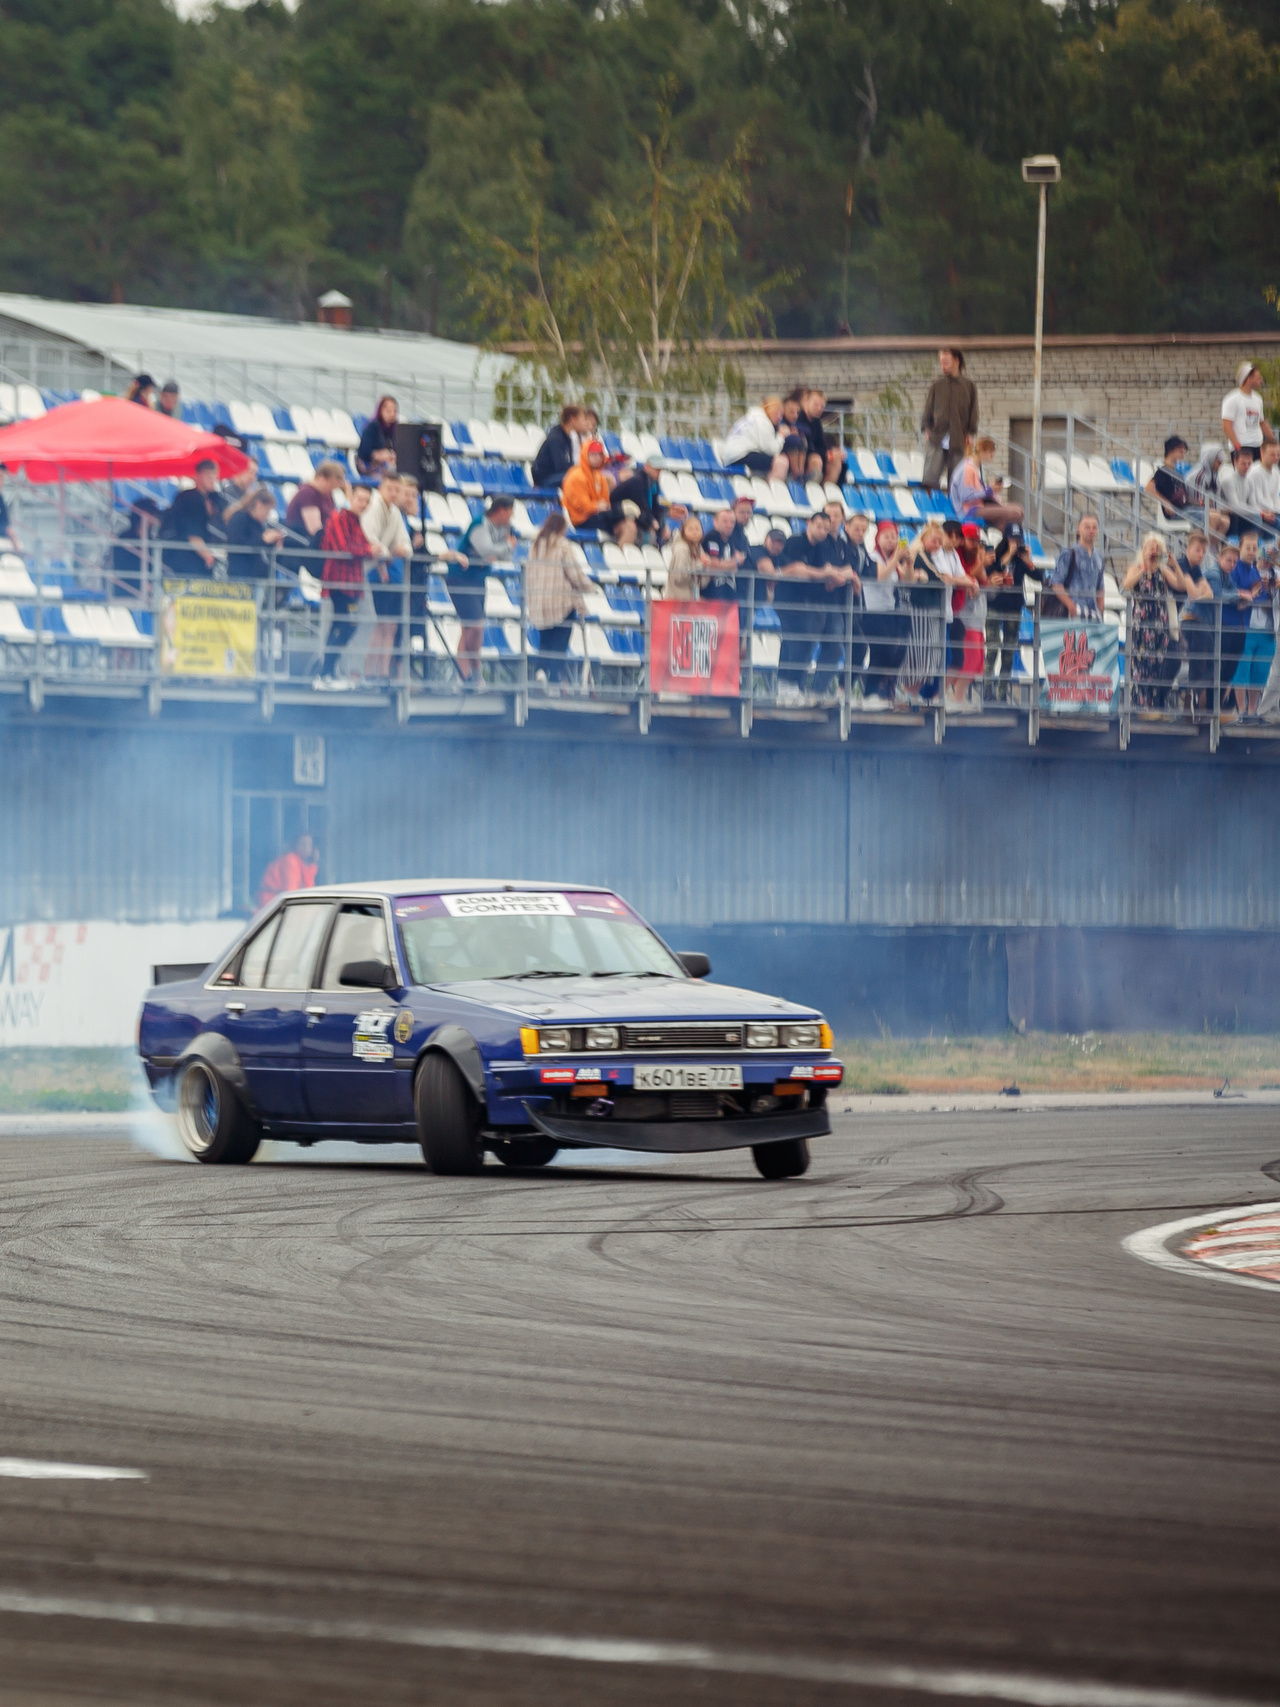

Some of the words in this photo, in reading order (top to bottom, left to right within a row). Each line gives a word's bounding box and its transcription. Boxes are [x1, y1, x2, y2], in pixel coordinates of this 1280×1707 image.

[671, 616, 694, 676] NO
[694, 618, 718, 648] DRIFT
[694, 648, 711, 677] FUN
[455, 897, 499, 905] ADM
[459, 904, 560, 913] CONTEST
